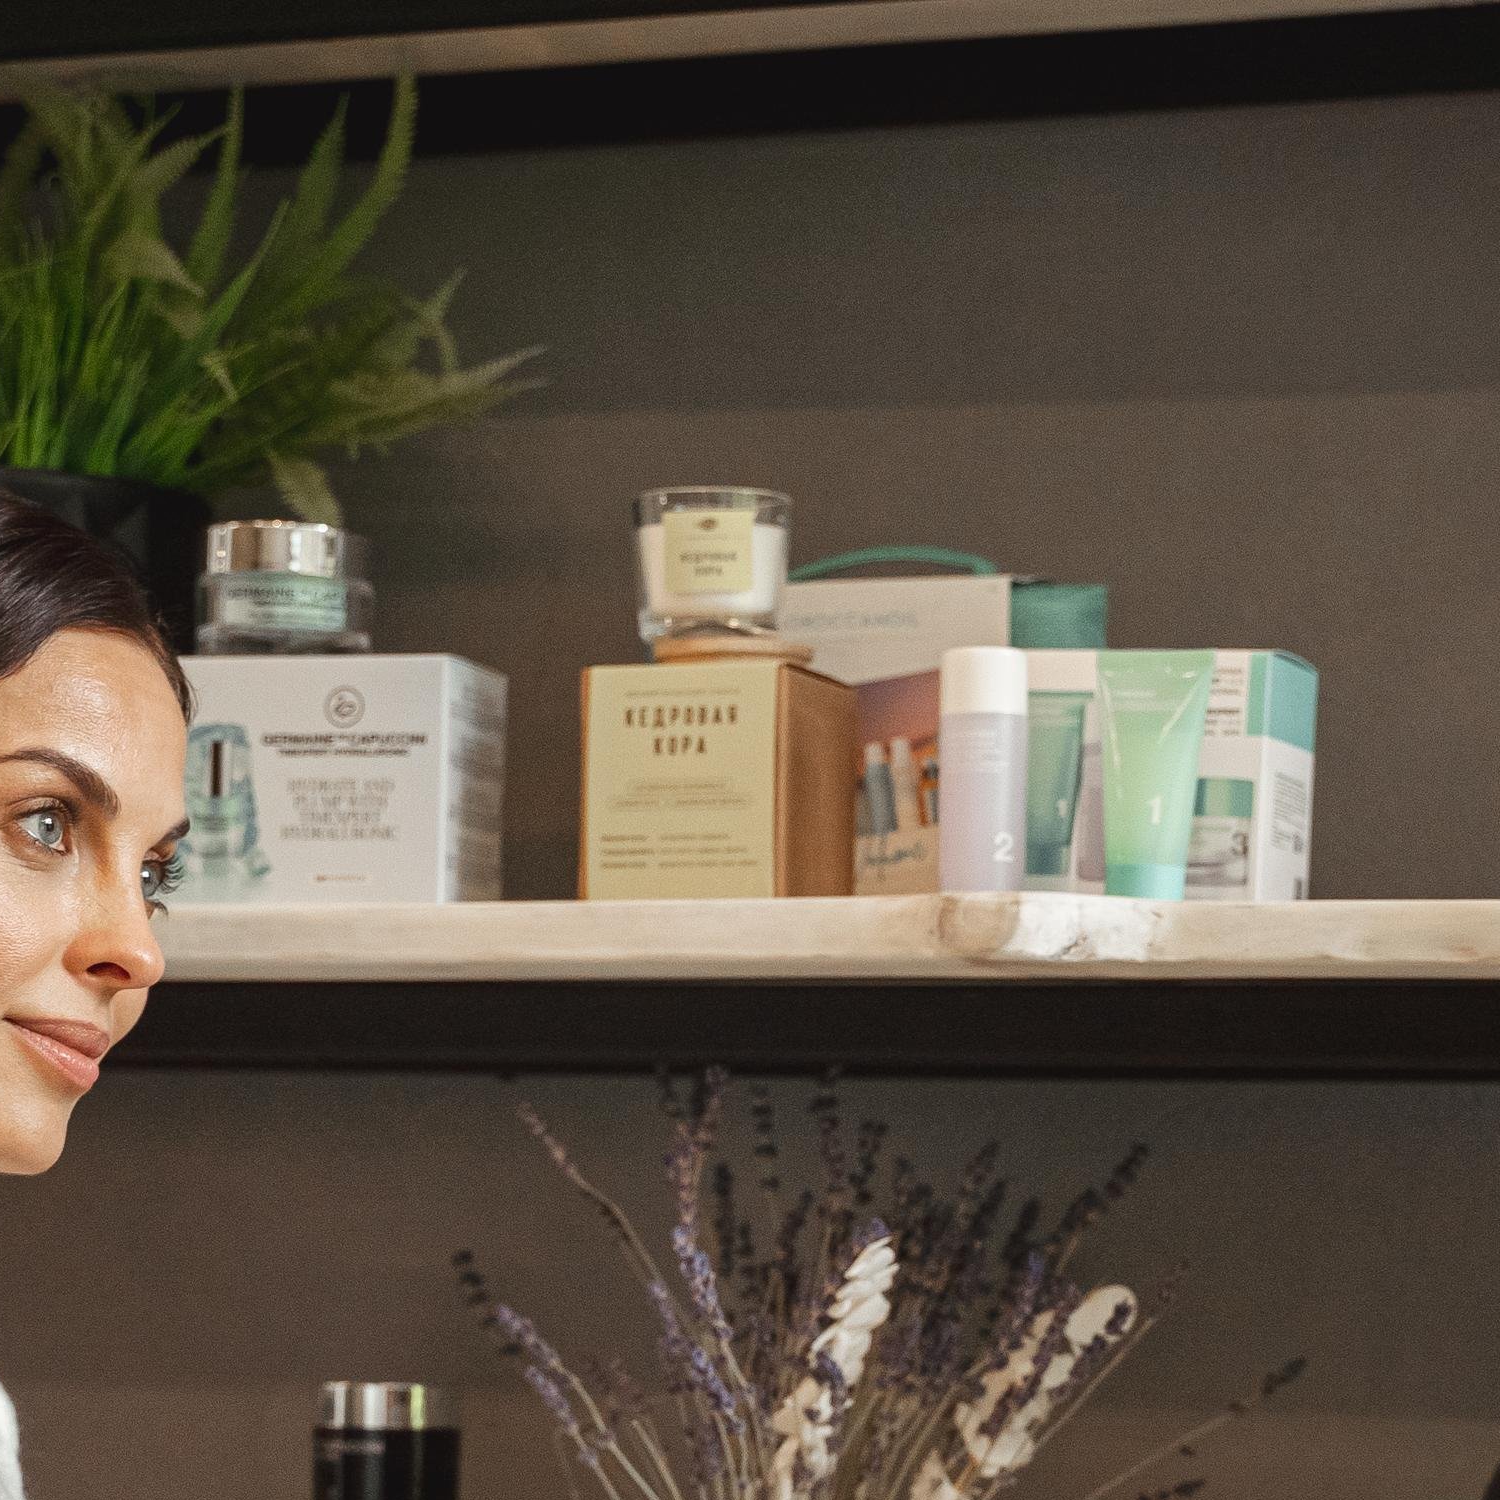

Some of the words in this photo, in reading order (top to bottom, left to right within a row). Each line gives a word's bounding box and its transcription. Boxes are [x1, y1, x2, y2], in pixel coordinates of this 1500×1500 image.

[623, 703, 739, 728] КЕДРОВАЯ
[653, 734, 707, 756] КОРА
[1149, 795, 1162, 826] 1
[992, 830, 1014, 863] 2
